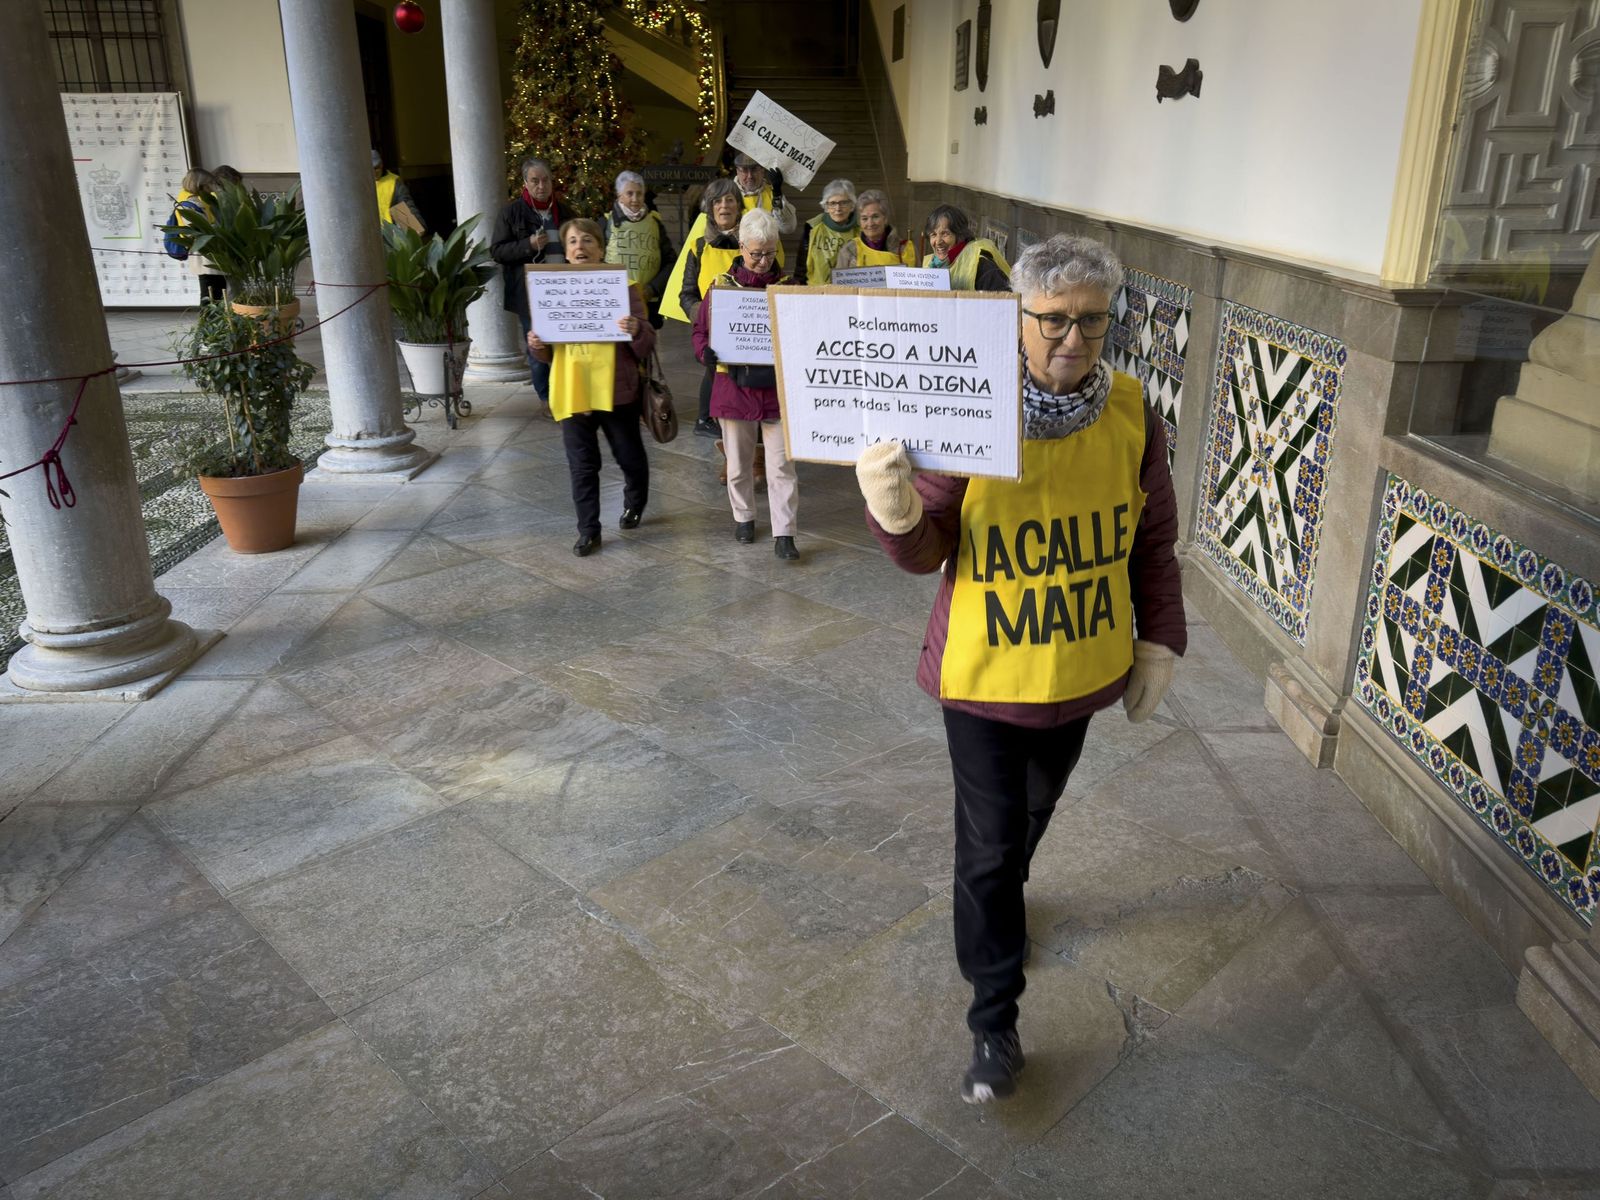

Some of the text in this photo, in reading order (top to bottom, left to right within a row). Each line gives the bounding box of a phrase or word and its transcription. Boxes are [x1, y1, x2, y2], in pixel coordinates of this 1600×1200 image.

[742, 115, 757, 131] LA
[757, 126, 789, 154] CALLE
[786, 146, 816, 173] MATA.
[570, 277, 582, 285] EN
[584, 277, 594, 285] LA
[597, 277, 621, 285] CALLE
[569, 299, 601, 307] CIERRE
[604, 299, 621, 307] DEL
[586, 311, 598, 319] DE
[601, 311, 612, 319] LA
[558, 323, 569, 331] C/
[848, 316, 939, 333] Reclamamos
[815, 340, 978, 364] ACCESO A UNA
[805, 367, 993, 395] VIVIENDA DIGNA
[814, 395, 993, 420] para todas las personas
[811, 431, 855, 447] Porque
[984, 575, 1116, 648] MATA
